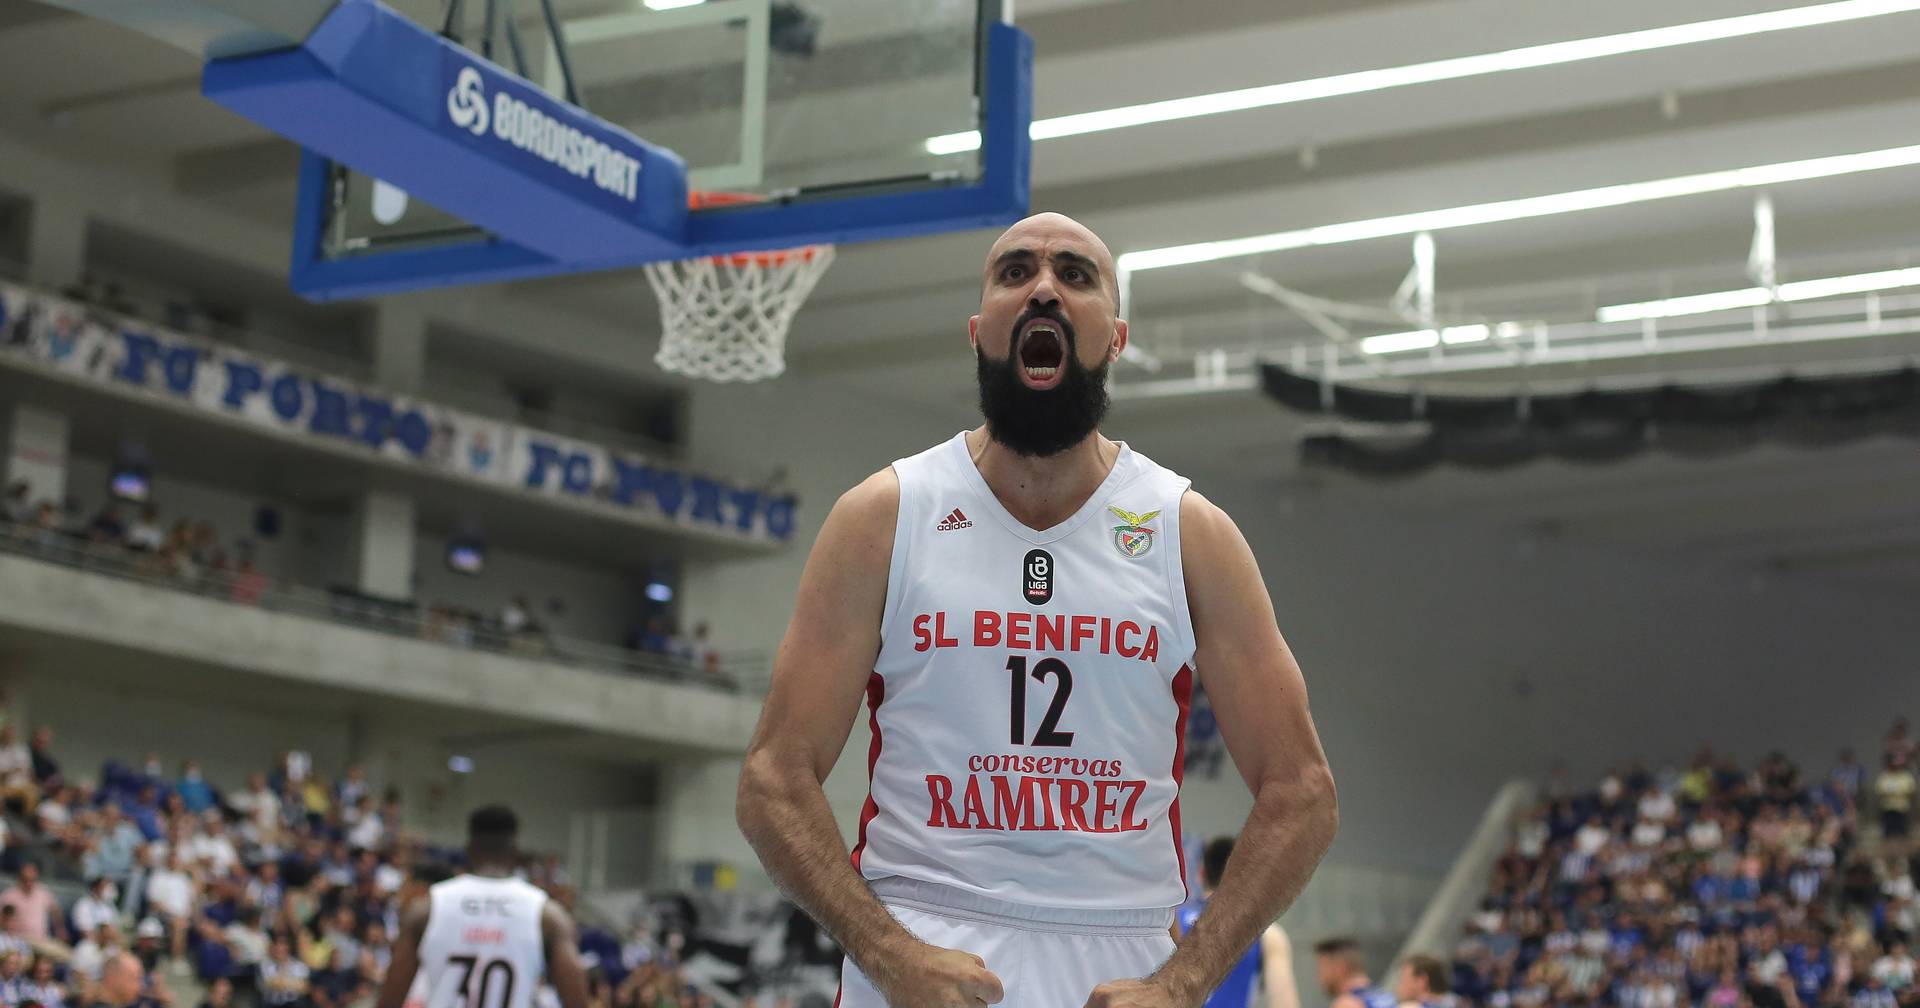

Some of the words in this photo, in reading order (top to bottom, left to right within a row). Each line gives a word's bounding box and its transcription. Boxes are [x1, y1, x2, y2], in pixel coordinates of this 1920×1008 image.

[493, 92, 641, 202] BORDISPORT
[224, 360, 433, 457] PORTO
[937, 521, 973, 531] adidas
[913, 611, 959, 652] SL
[973, 610, 1159, 663] BENFICA
[1005, 655, 1075, 747] 12
[968, 754, 1122, 777] conservas
[925, 774, 1148, 833] RAMIREZ
[448, 955, 515, 1008] 30
